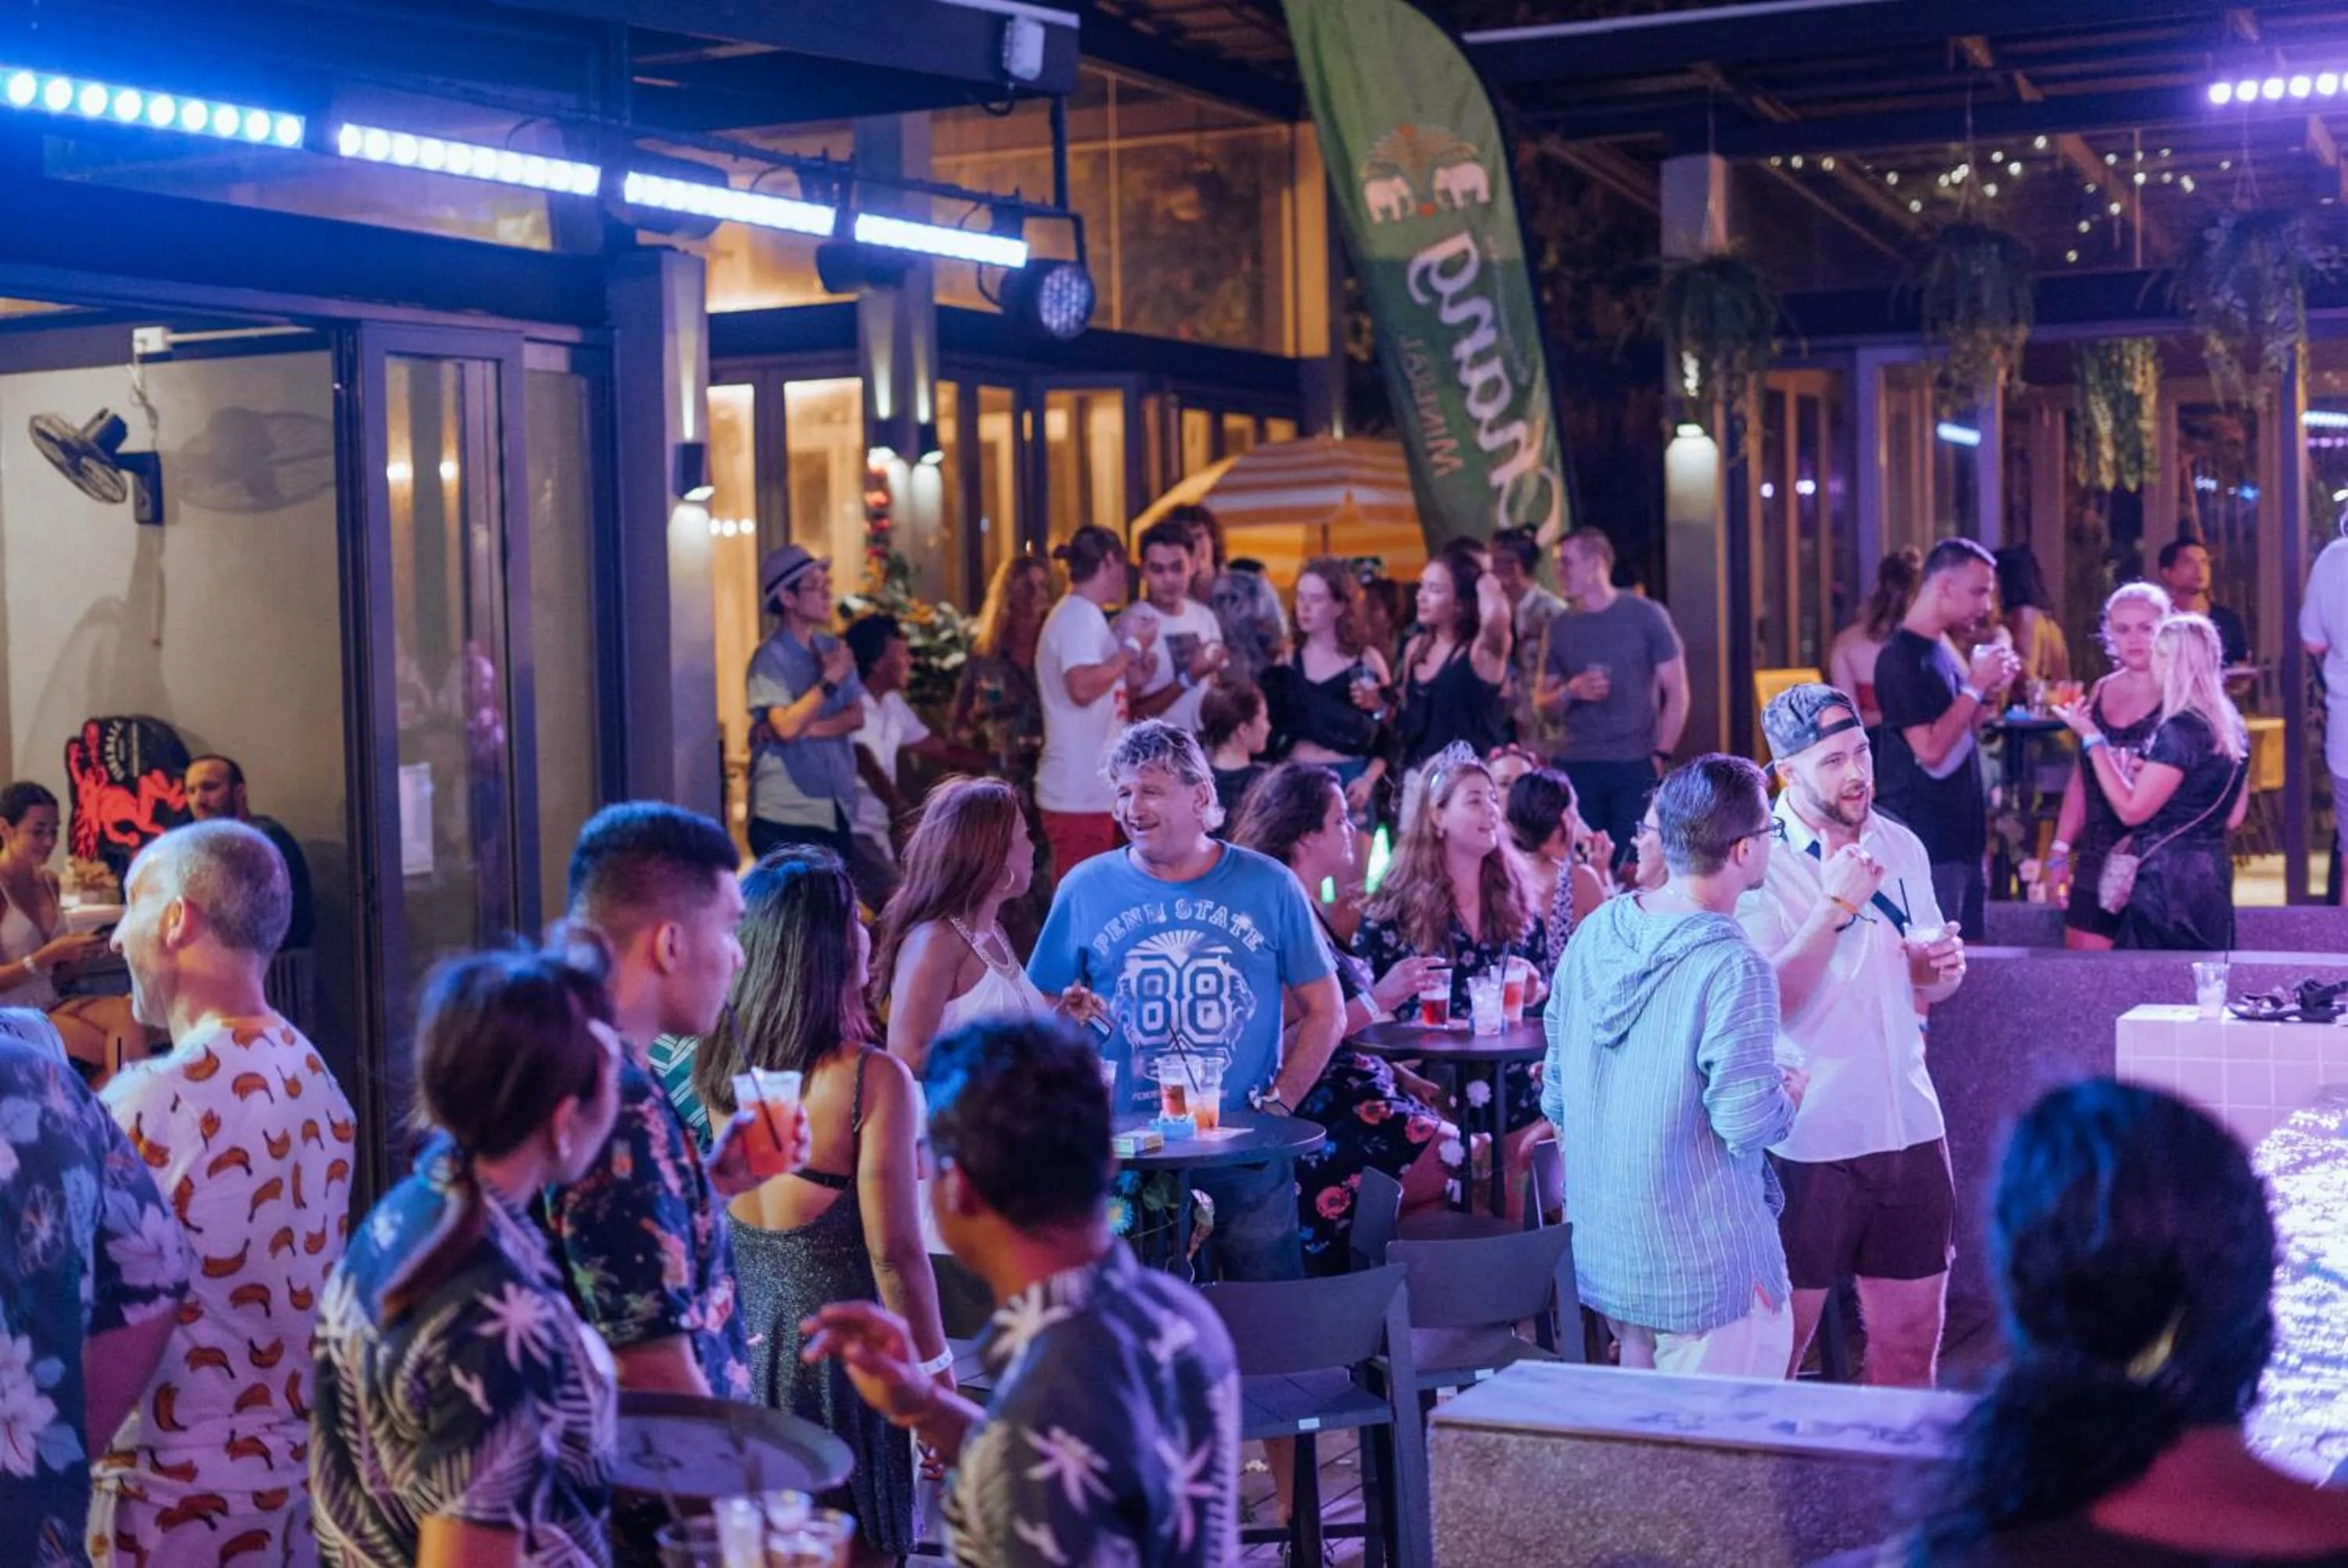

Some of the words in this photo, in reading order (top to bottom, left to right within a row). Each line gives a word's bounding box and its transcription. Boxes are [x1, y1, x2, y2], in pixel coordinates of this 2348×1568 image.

[1092, 902, 1167, 956] PENN
[1175, 898, 1265, 952] STATE
[1131, 958, 1233, 1046] 88
